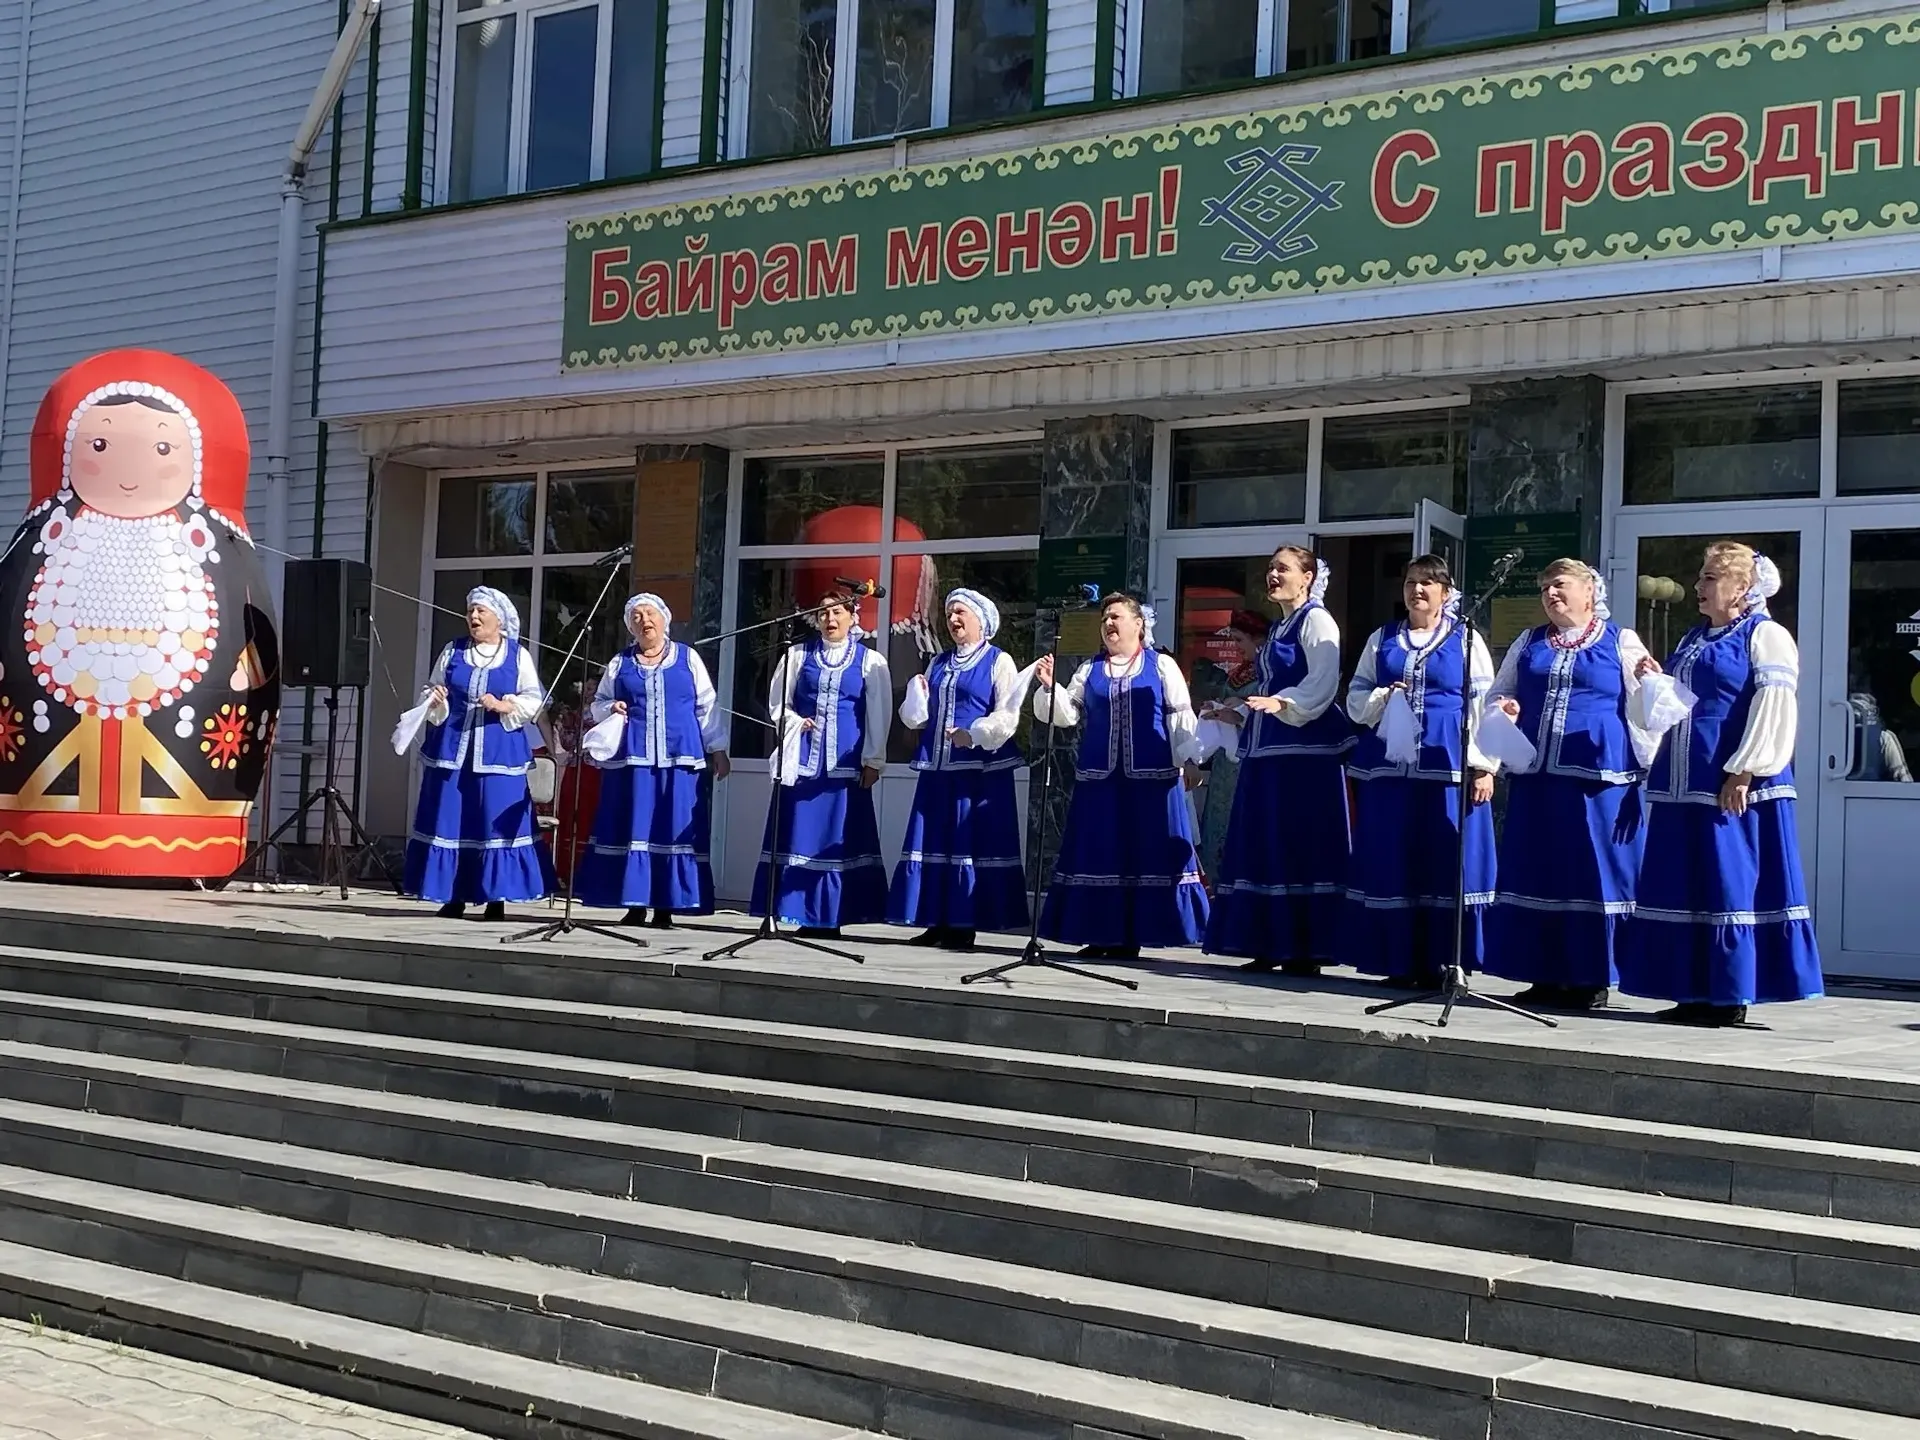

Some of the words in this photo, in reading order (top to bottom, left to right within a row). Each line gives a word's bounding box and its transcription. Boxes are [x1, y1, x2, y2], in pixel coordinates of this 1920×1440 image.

[1370, 129, 1441, 229] С
[1475, 87, 1920, 236] праздн
[589, 233, 859, 332] Байрам
[886, 164, 1183, 290] менән!
